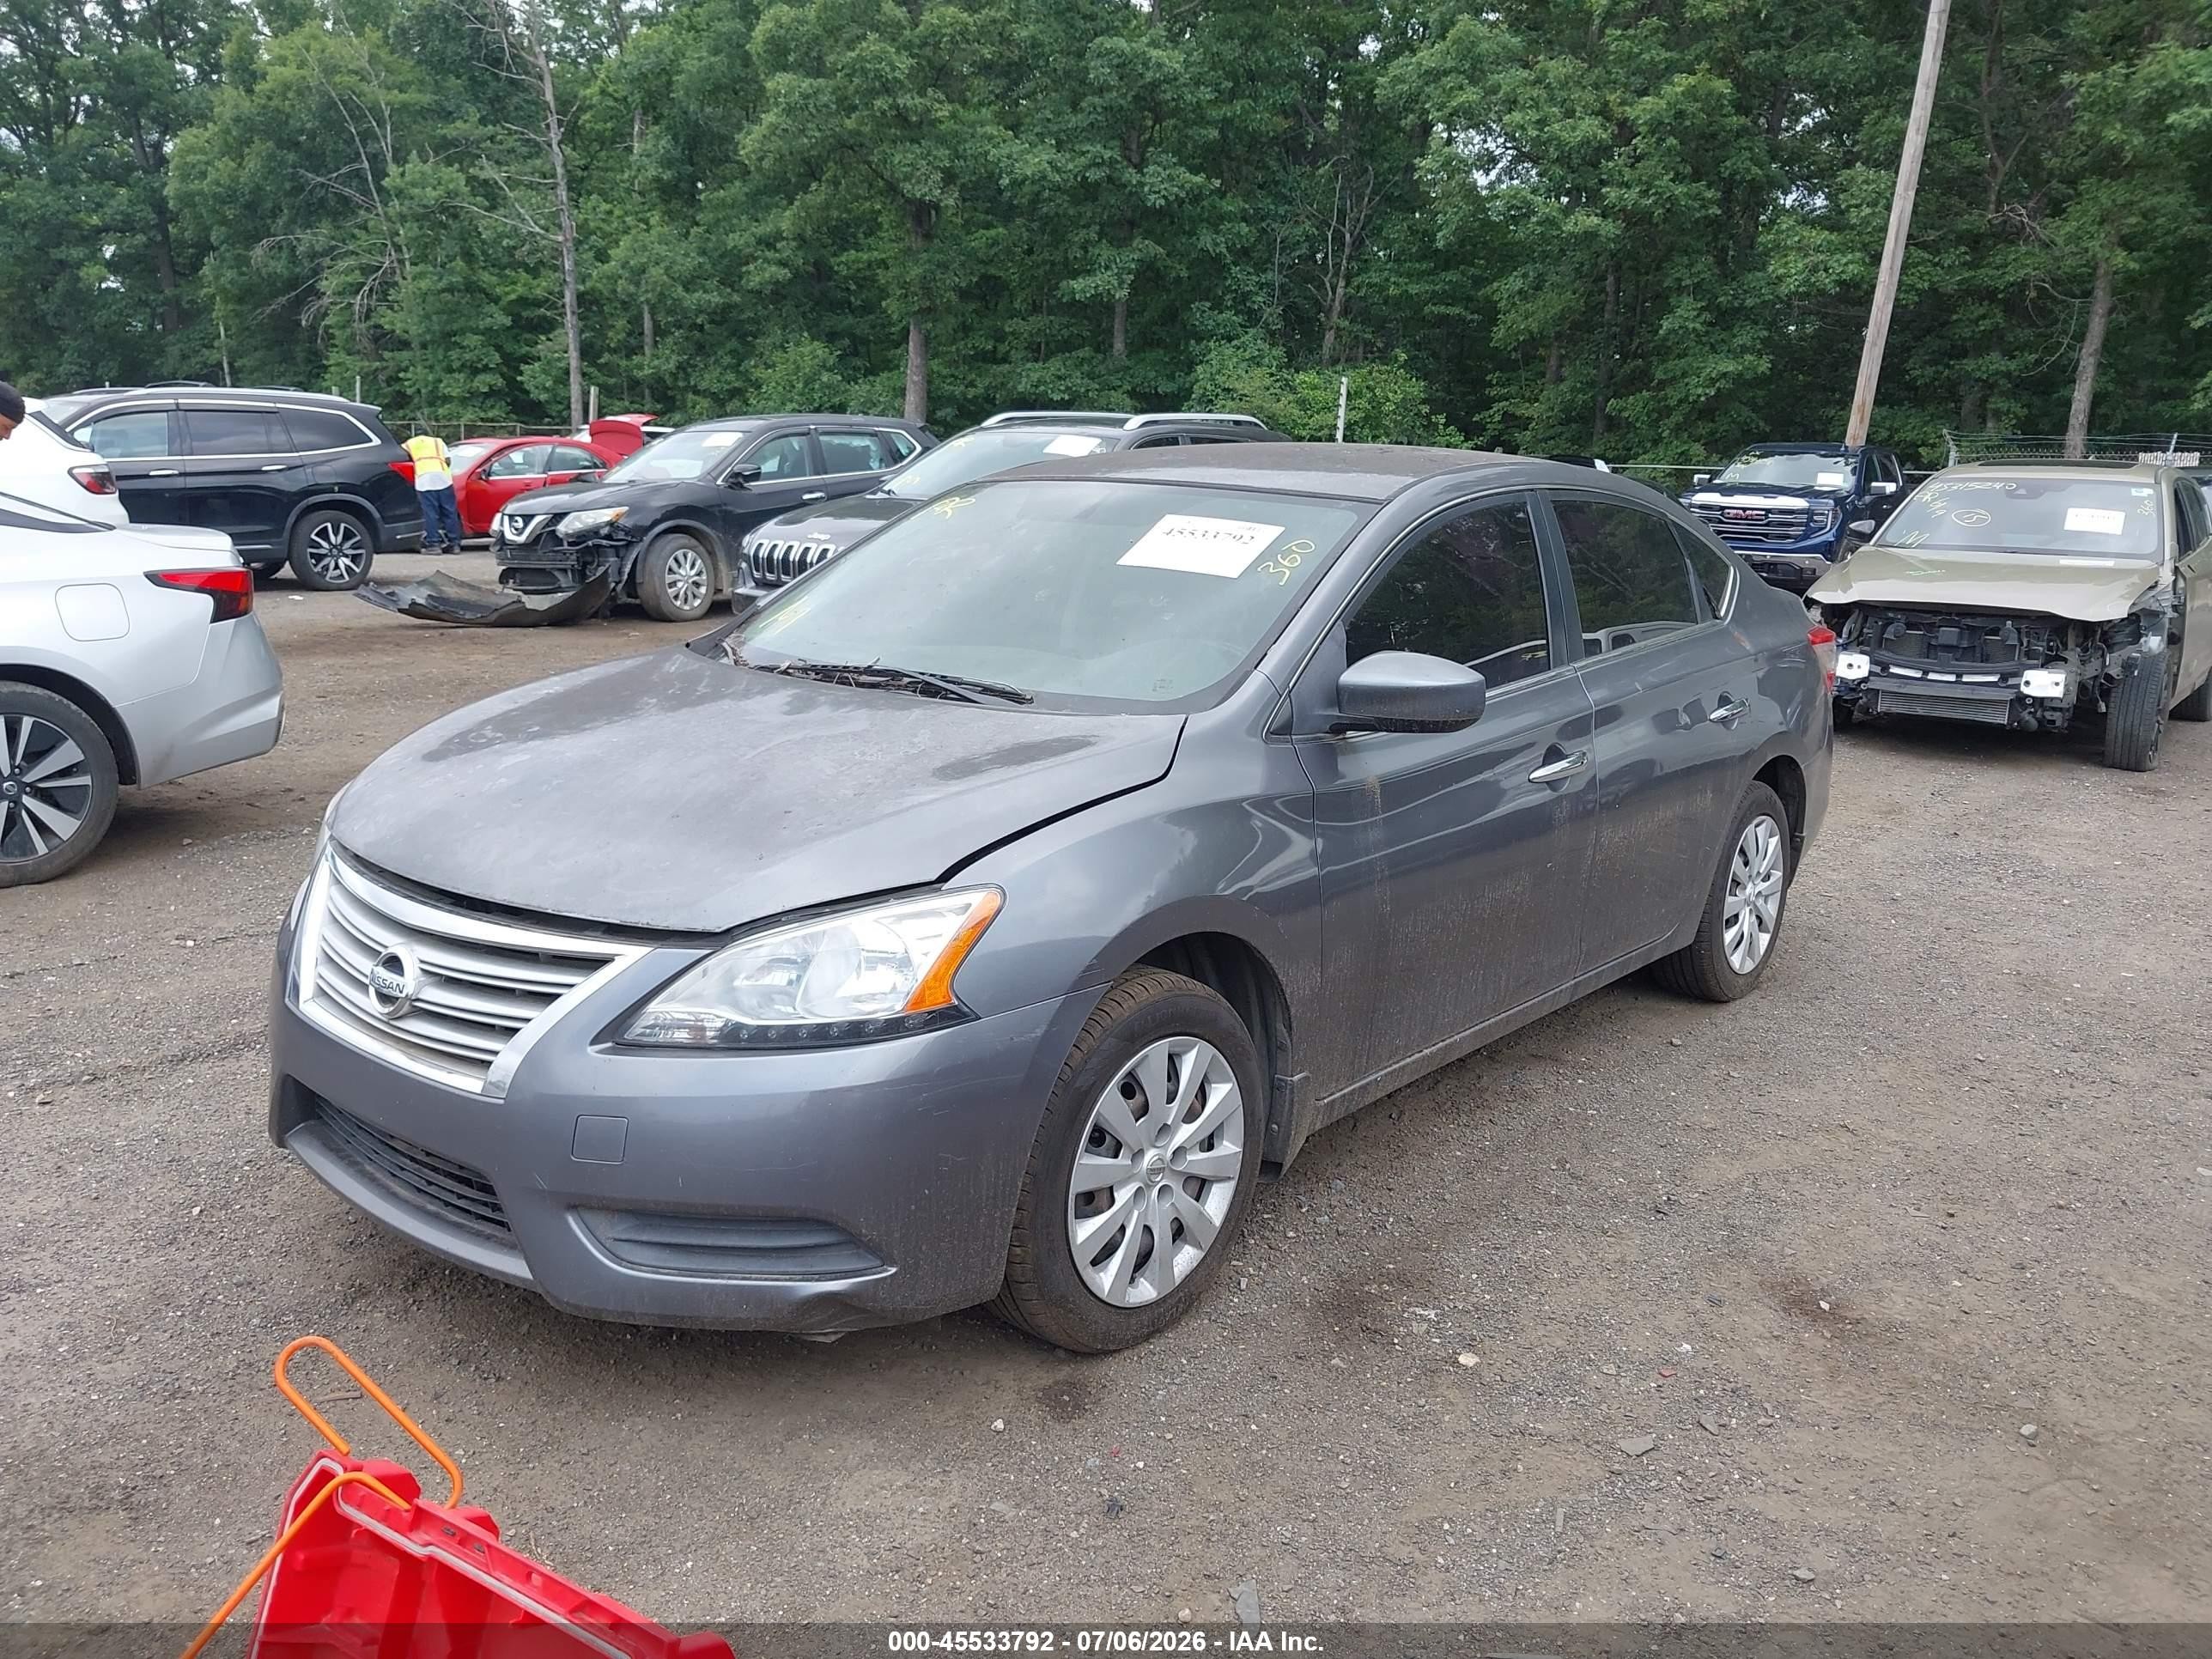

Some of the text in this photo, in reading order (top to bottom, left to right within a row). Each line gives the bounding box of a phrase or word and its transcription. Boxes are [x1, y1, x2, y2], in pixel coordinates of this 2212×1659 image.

[1723, 509, 1765, 520] GMC
[1256, 539, 1316, 586] 360
[370, 968, 405, 994] NISSAN
